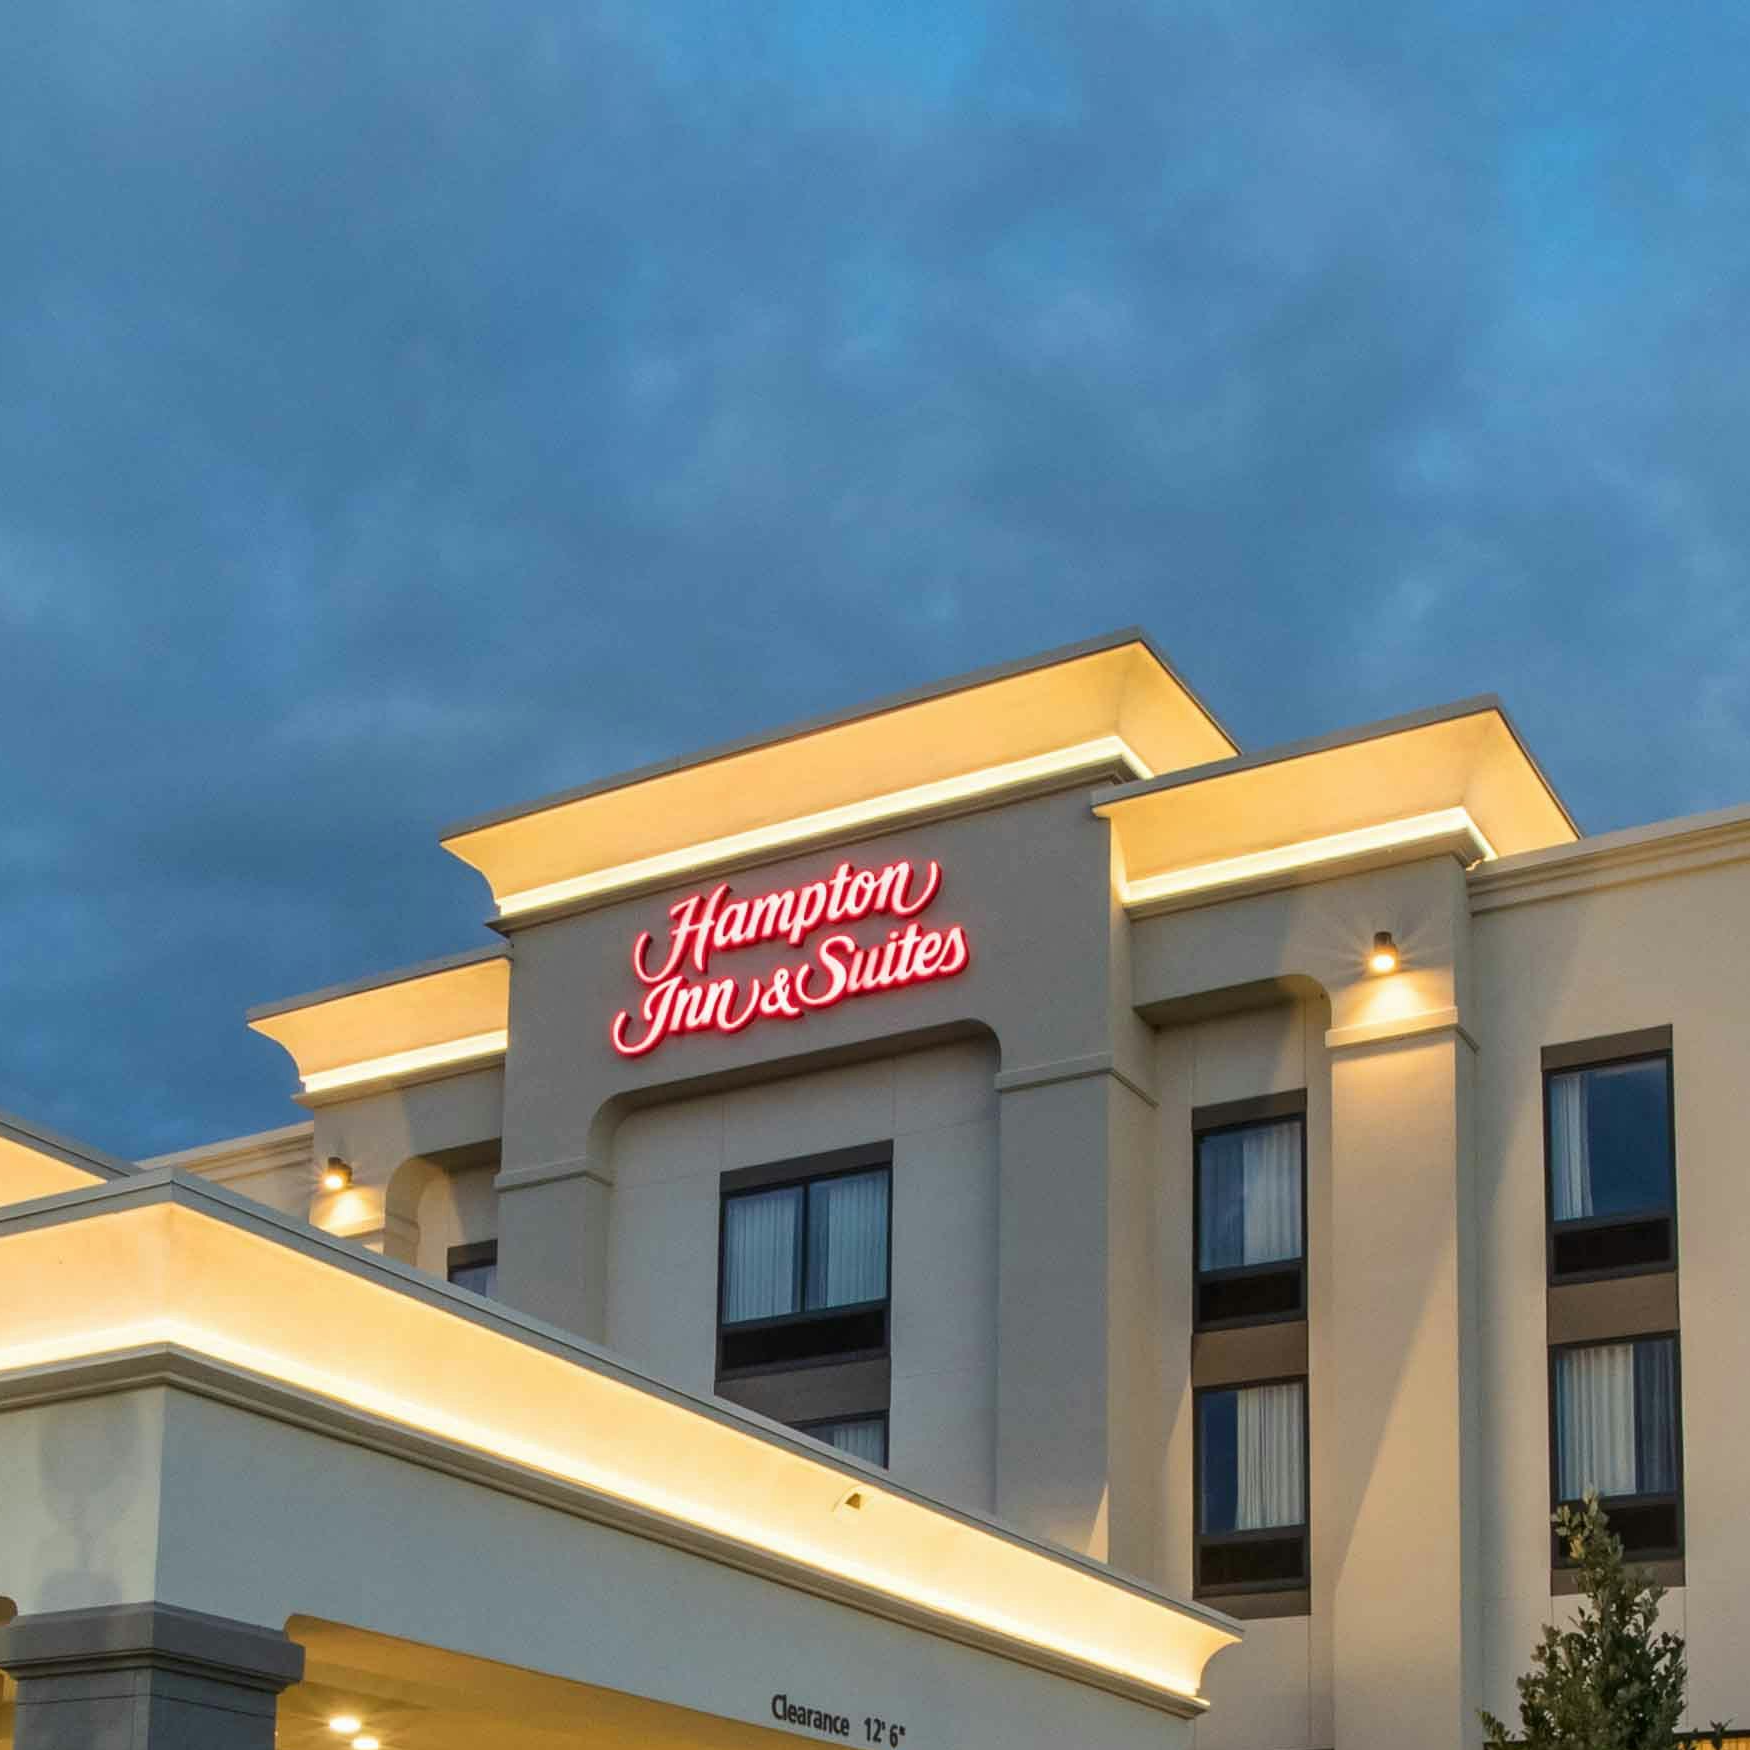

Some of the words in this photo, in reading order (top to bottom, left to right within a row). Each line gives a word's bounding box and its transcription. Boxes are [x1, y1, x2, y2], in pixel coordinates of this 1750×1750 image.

[634, 859, 942, 984] Hampton
[611, 974, 760, 1057] Inn
[761, 966, 804, 1017] &
[795, 920, 970, 1007] Suites
[771, 1694, 850, 1736] Clearance
